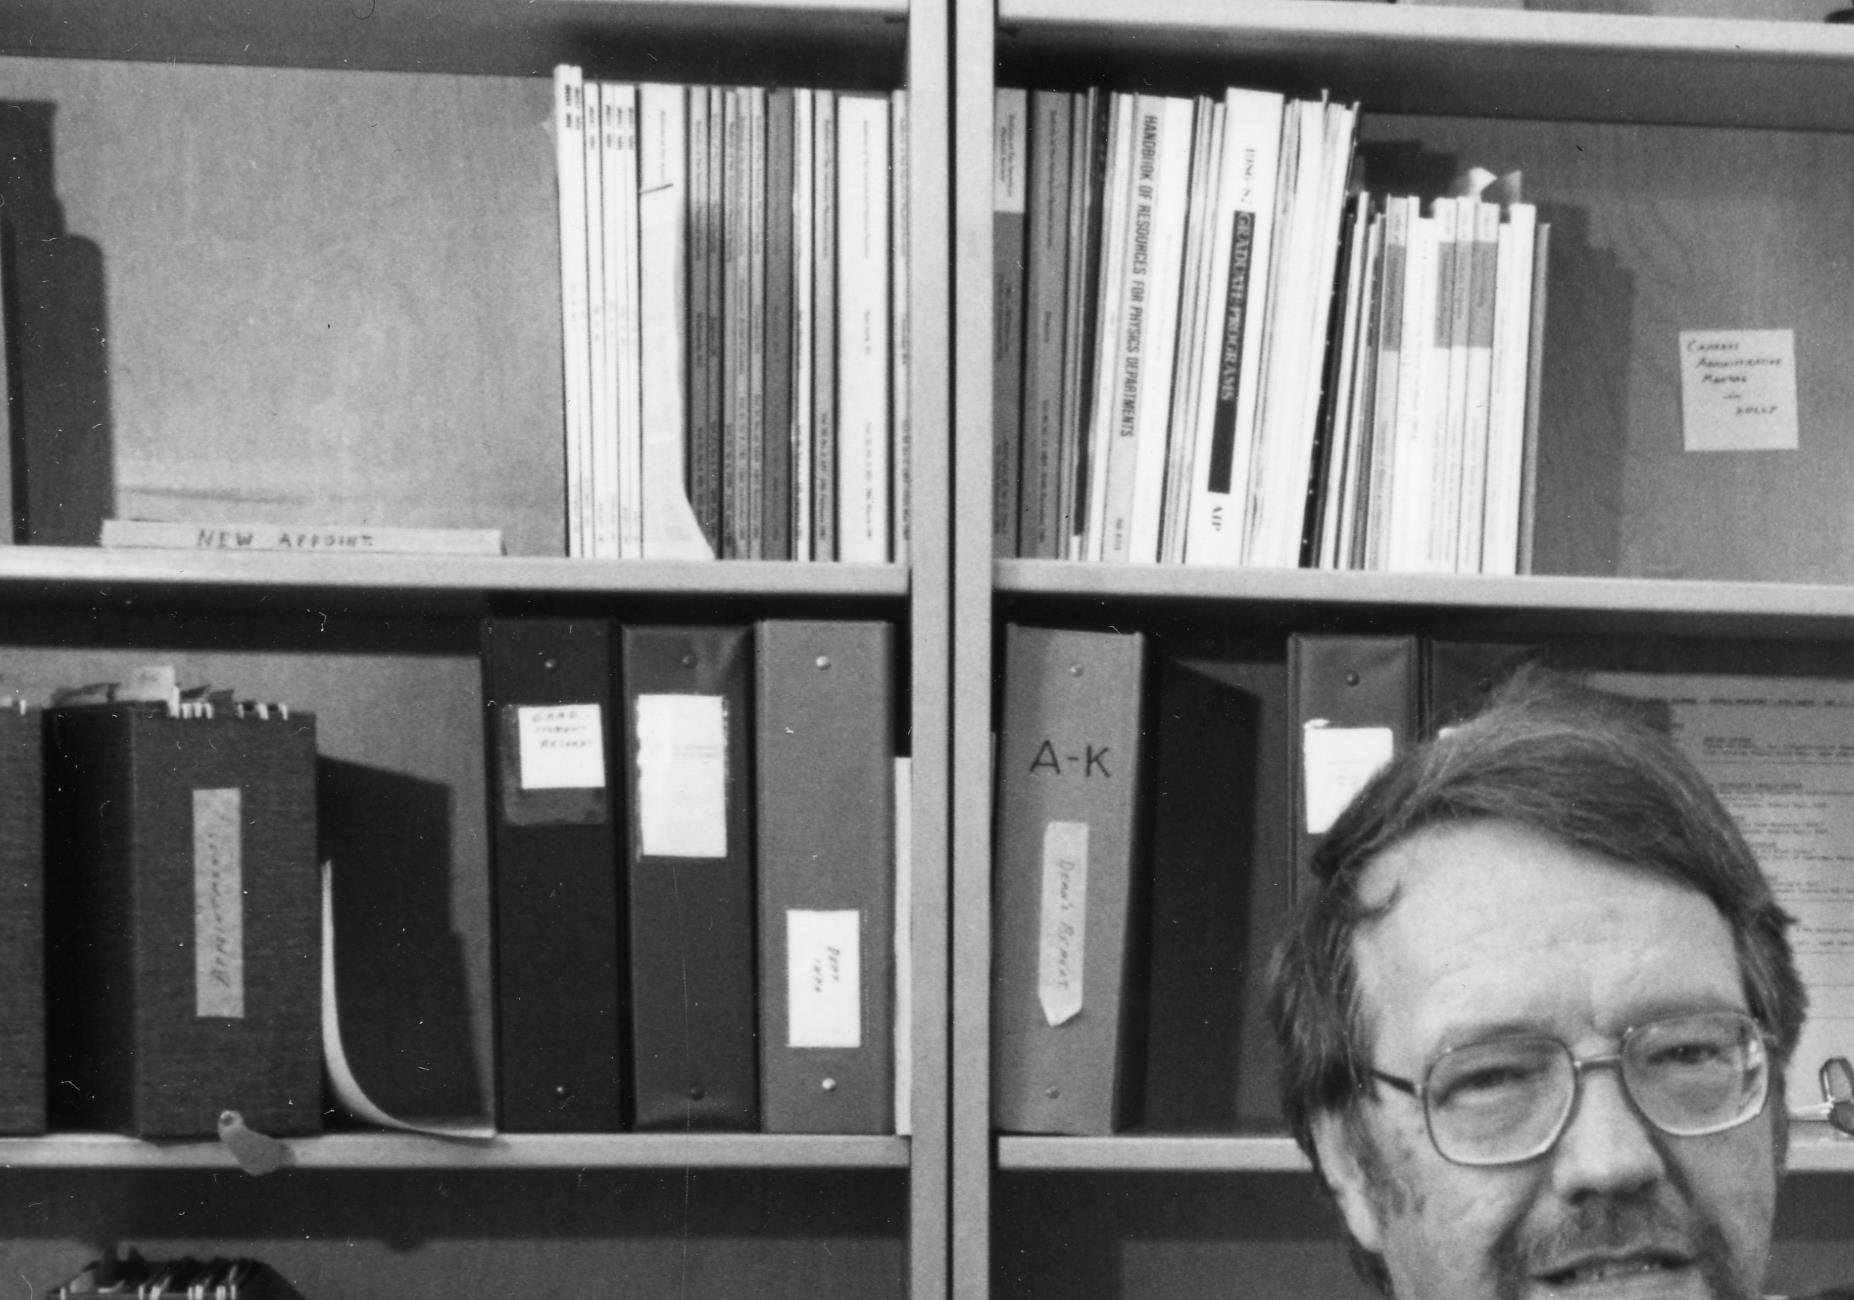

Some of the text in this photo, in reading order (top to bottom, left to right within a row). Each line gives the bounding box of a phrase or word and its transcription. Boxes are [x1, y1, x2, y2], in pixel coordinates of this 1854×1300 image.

[1138, 184, 1154, 200] OF
[1131, 203, 1154, 275] RESOURCES
[1228, 212, 1251, 302] GRADUATE
[1129, 279, 1146, 304] FOR
[1124, 305, 1144, 355] PHYSICS
[1220, 303, 1243, 401] PROGRAMS
[1119, 356, 1138, 439] DEPARTMENTS
[196, 528, 254, 548] NEW
[1029, 739, 1111, 778] A-K
